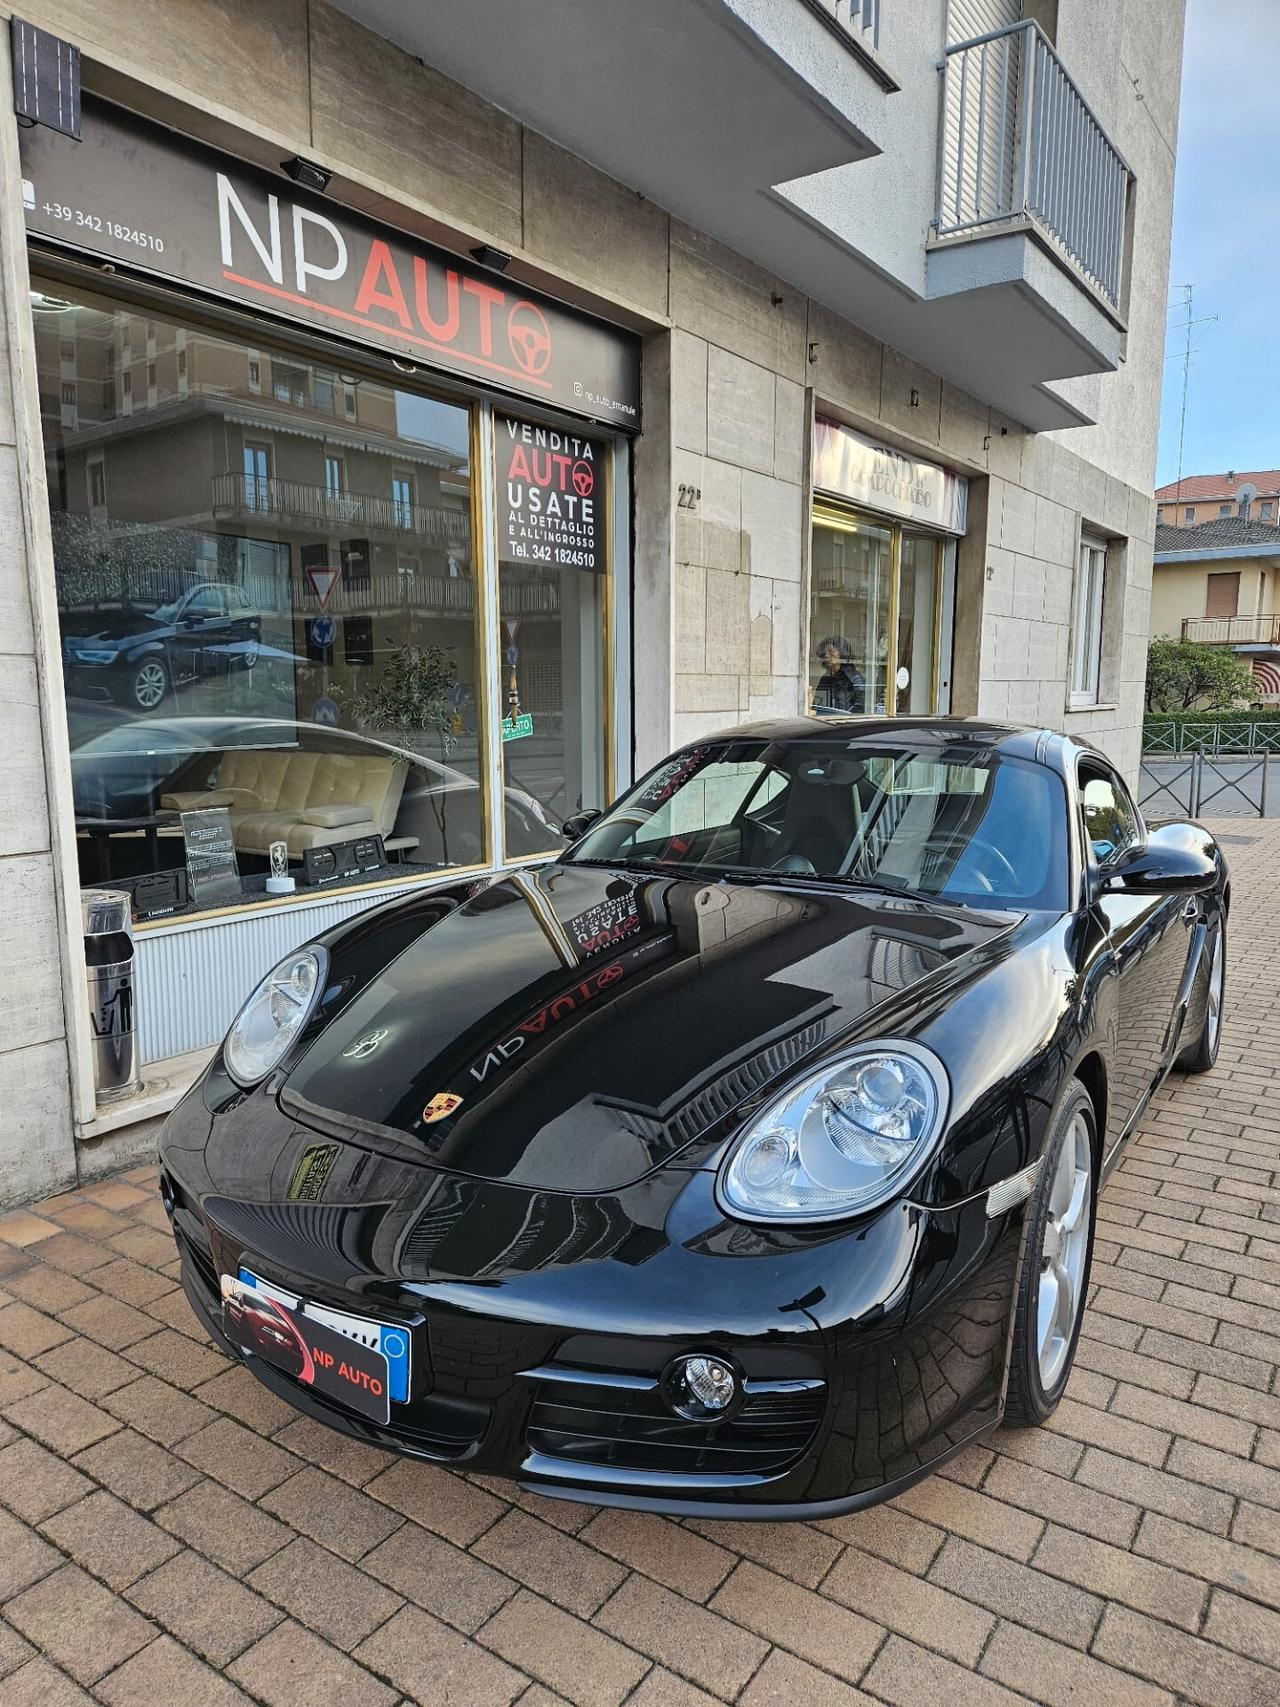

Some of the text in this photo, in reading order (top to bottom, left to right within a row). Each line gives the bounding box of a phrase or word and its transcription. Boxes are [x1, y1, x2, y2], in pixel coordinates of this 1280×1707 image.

[43, 202, 164, 253] +39 342 1824510
[506, 419, 594, 461] VENDITA
[507, 444, 594, 497] AUTO
[507, 482, 594, 523] USATE
[508, 510, 595, 537] AL DETTAGLIO
[508, 524, 595, 549] E ALL'INGROSSO
[509, 540, 595, 568] Tel. 342 1824510
[312, 1346, 383, 1397] NP AUTO
